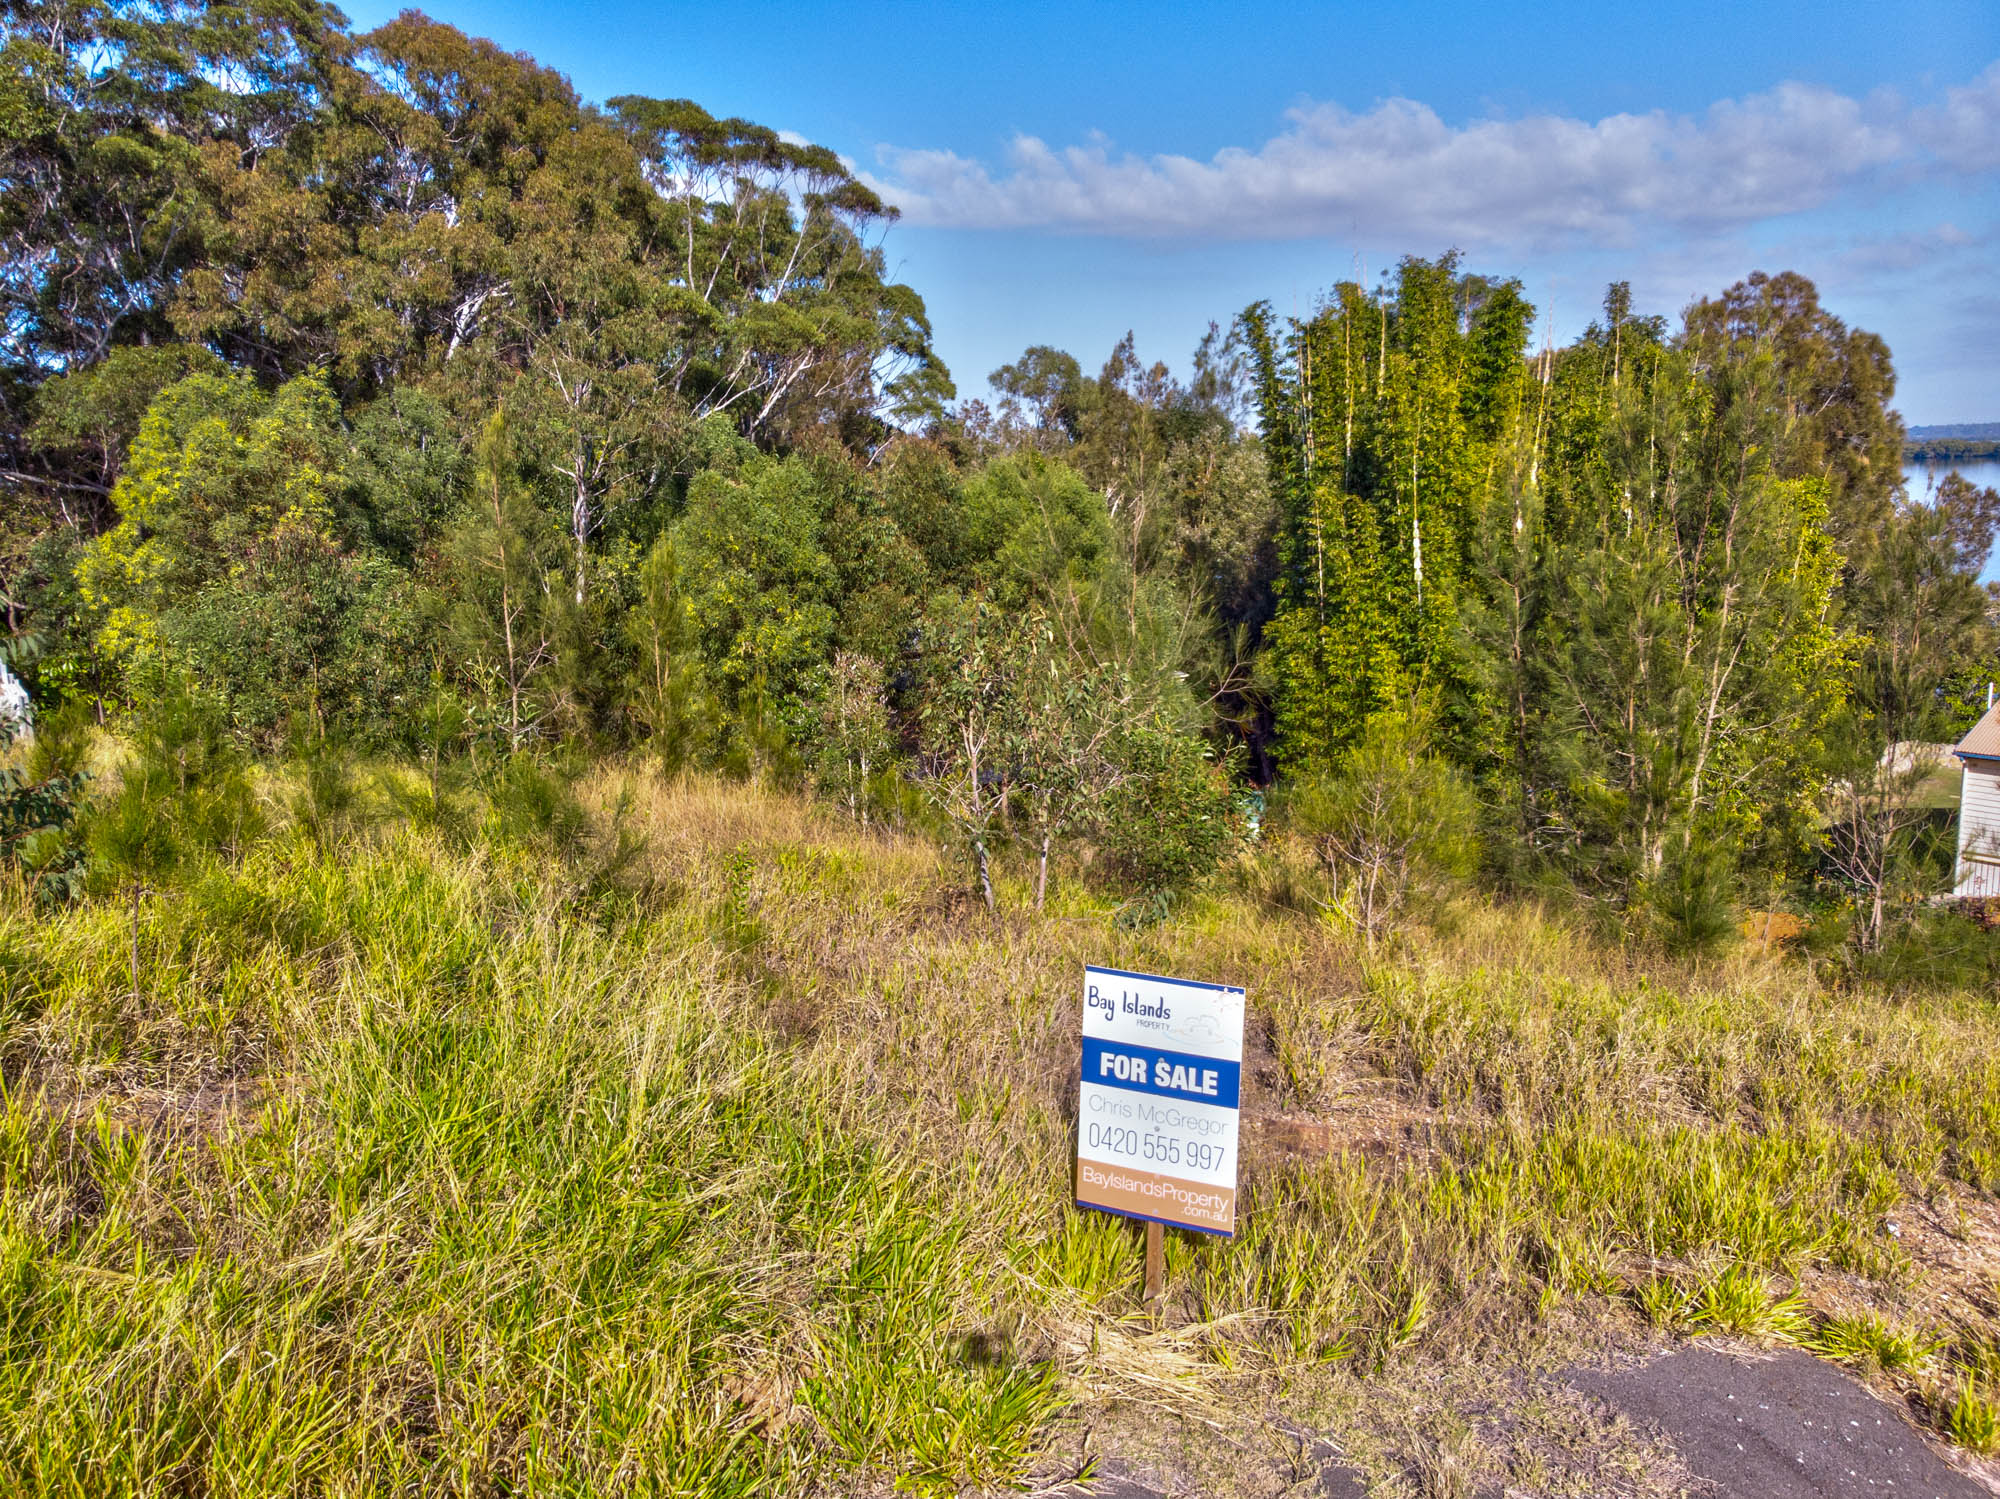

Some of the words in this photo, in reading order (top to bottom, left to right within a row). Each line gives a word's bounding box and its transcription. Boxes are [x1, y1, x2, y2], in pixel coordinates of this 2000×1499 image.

[1088, 985, 1115, 1021] Bay
[1122, 990, 1171, 1020] Islands
[1136, 1019, 1171, 1031] PROPERTY
[1100, 1052, 1147, 1084] FOR
[1154, 1060, 1218, 1096] SALE
[1088, 1094, 1132, 1118] Chris
[1138, 1103, 1229, 1136] McGregor
[1089, 1122, 1138, 1156] 0420
[1143, 1133, 1180, 1164] 555
[1186, 1141, 1225, 1172] 997
[1082, 1166, 1229, 1211] BayIslandsProperty
[1181, 1204, 1228, 1222] .com.au
